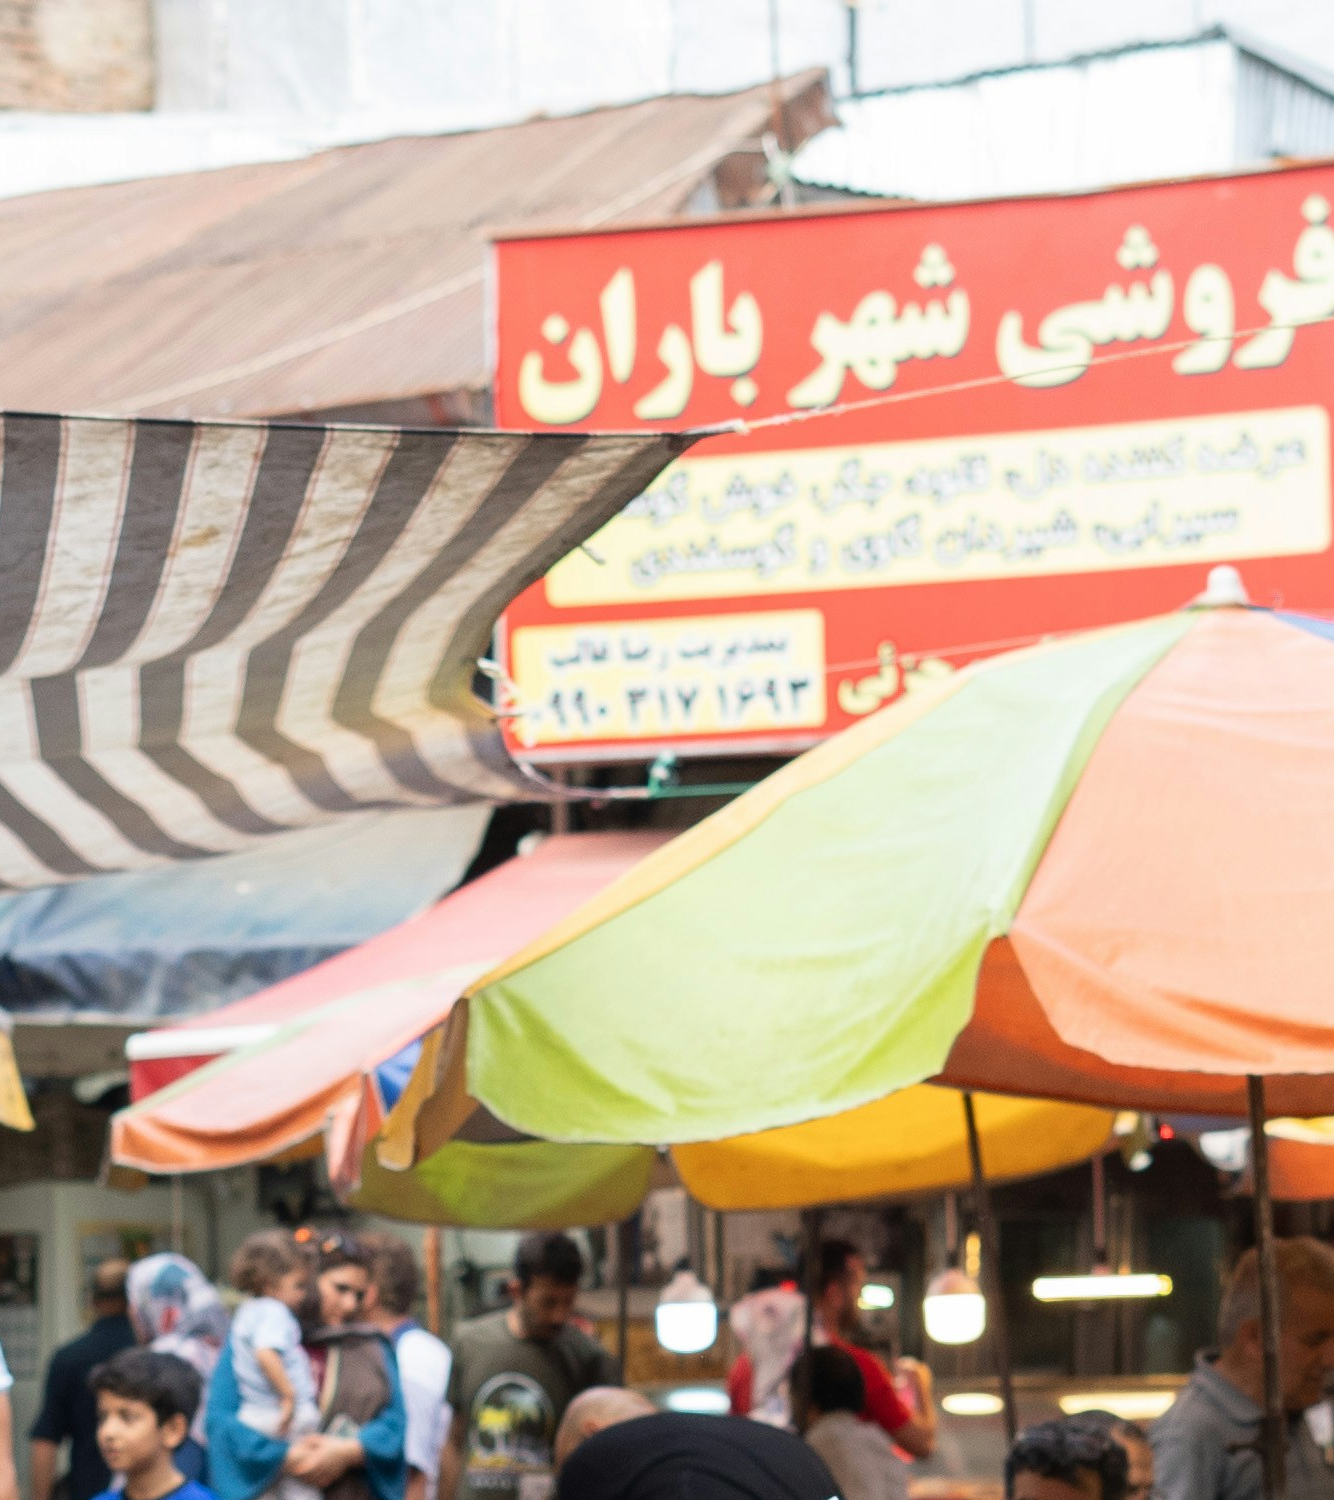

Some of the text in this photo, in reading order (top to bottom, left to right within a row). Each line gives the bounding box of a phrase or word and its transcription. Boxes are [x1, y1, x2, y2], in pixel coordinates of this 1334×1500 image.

[519, 259, 765, 424] باران
[786, 243, 969, 407] شهر
[1083, 433, 1186, 484] کننده
[1198, 433, 1306, 480] عرضه
